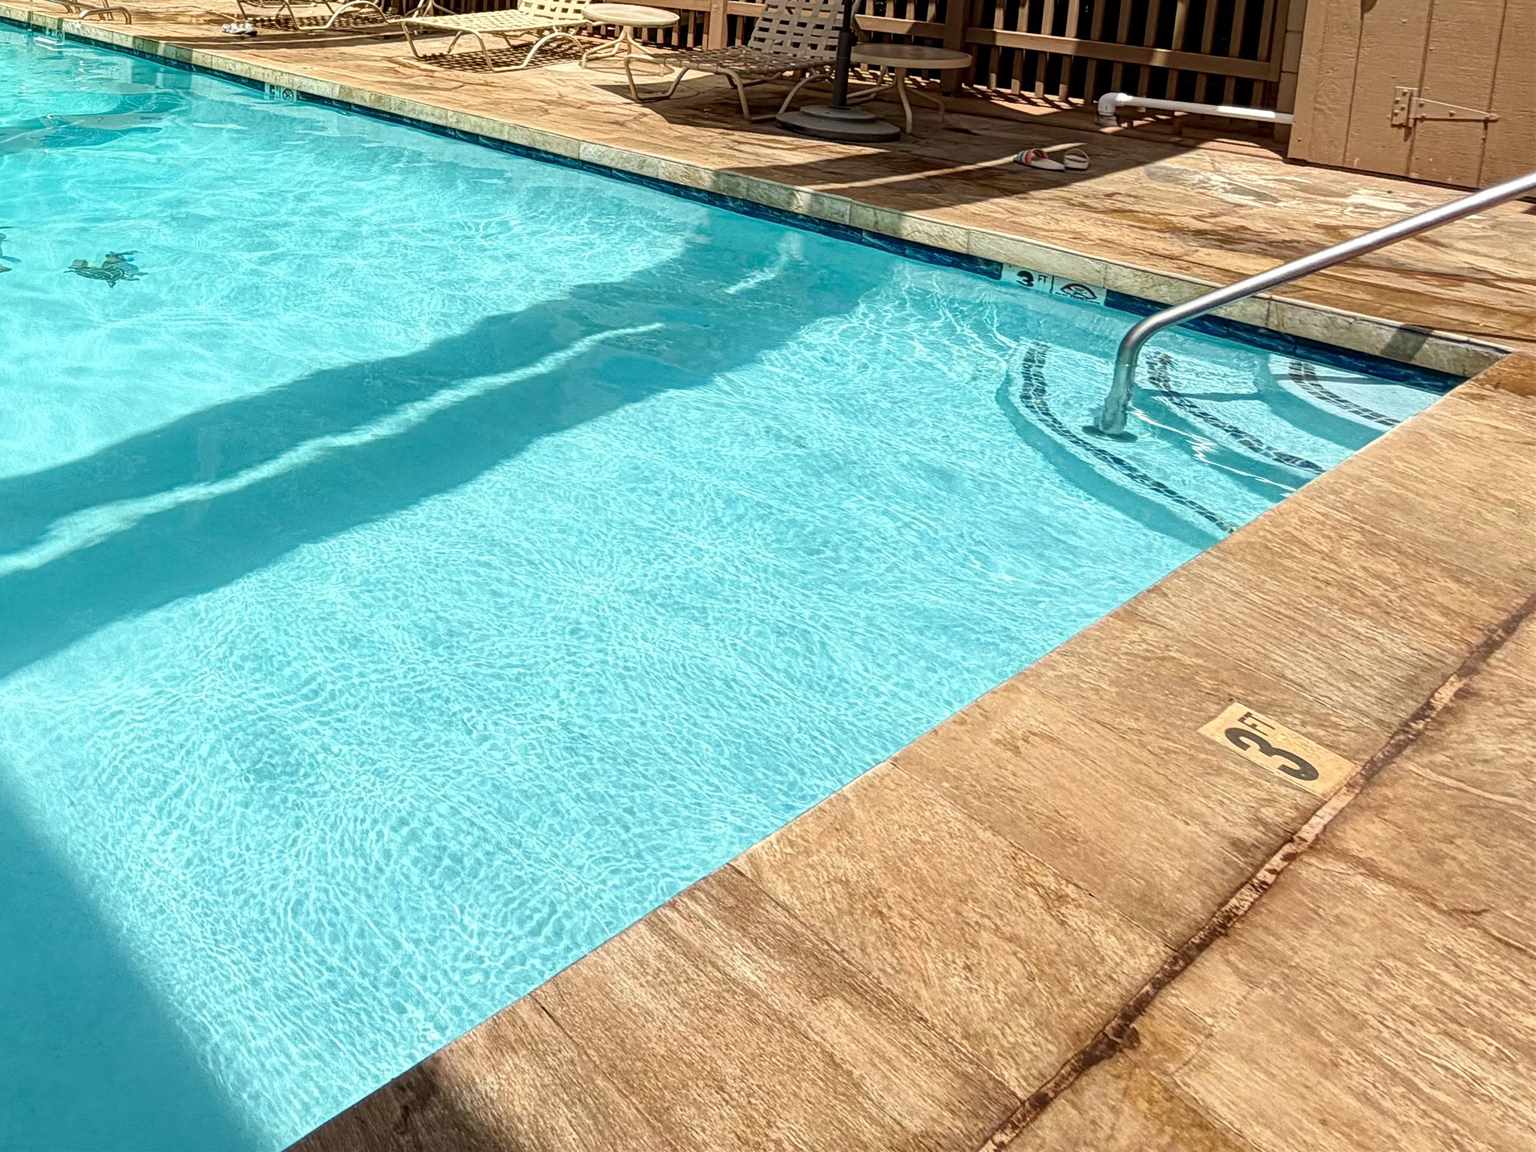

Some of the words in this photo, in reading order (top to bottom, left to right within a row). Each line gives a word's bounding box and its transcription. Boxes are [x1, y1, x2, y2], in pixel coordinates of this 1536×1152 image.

[1038, 274, 1049, 285] FT
[1238, 712, 1276, 737] FT
[1225, 727, 1319, 781] 3
